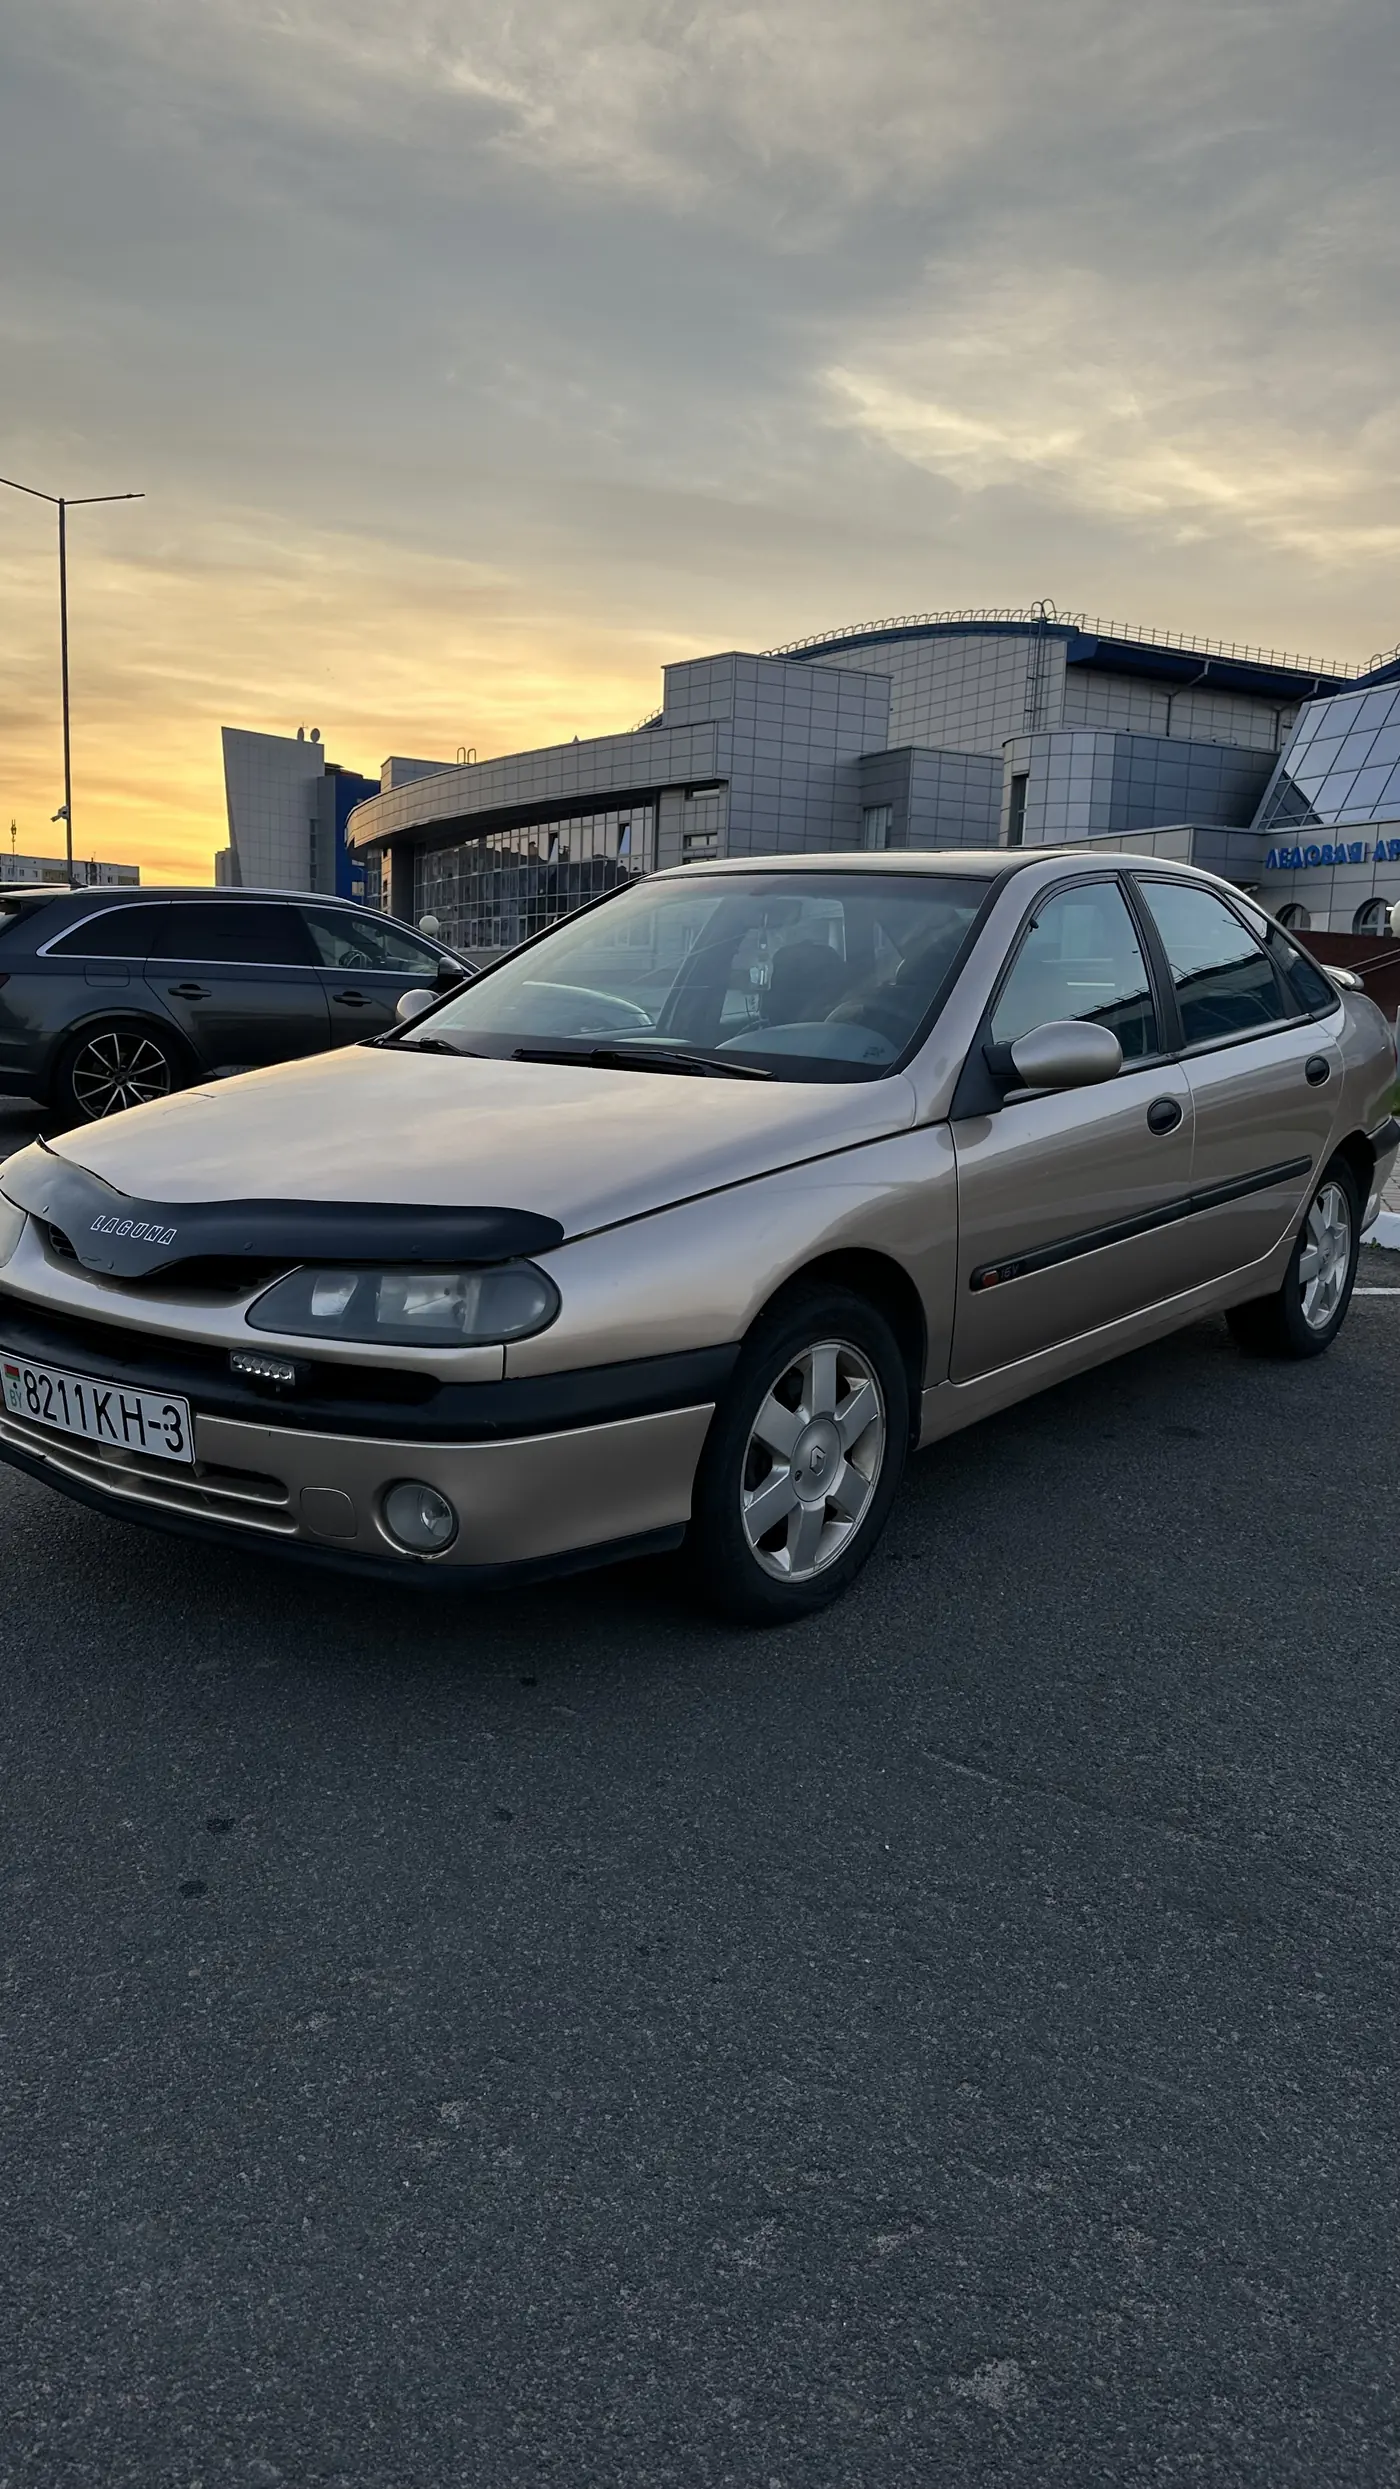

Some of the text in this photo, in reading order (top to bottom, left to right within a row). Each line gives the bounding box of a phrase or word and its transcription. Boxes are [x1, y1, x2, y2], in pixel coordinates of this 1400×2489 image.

[1265, 842, 1367, 869] ЛЕДОВАЯ
[90, 1214, 178, 1246] LAGUNA
[9, 1389, 23, 1409] BY
[23, 1369, 184, 1453] 8211KH-3
